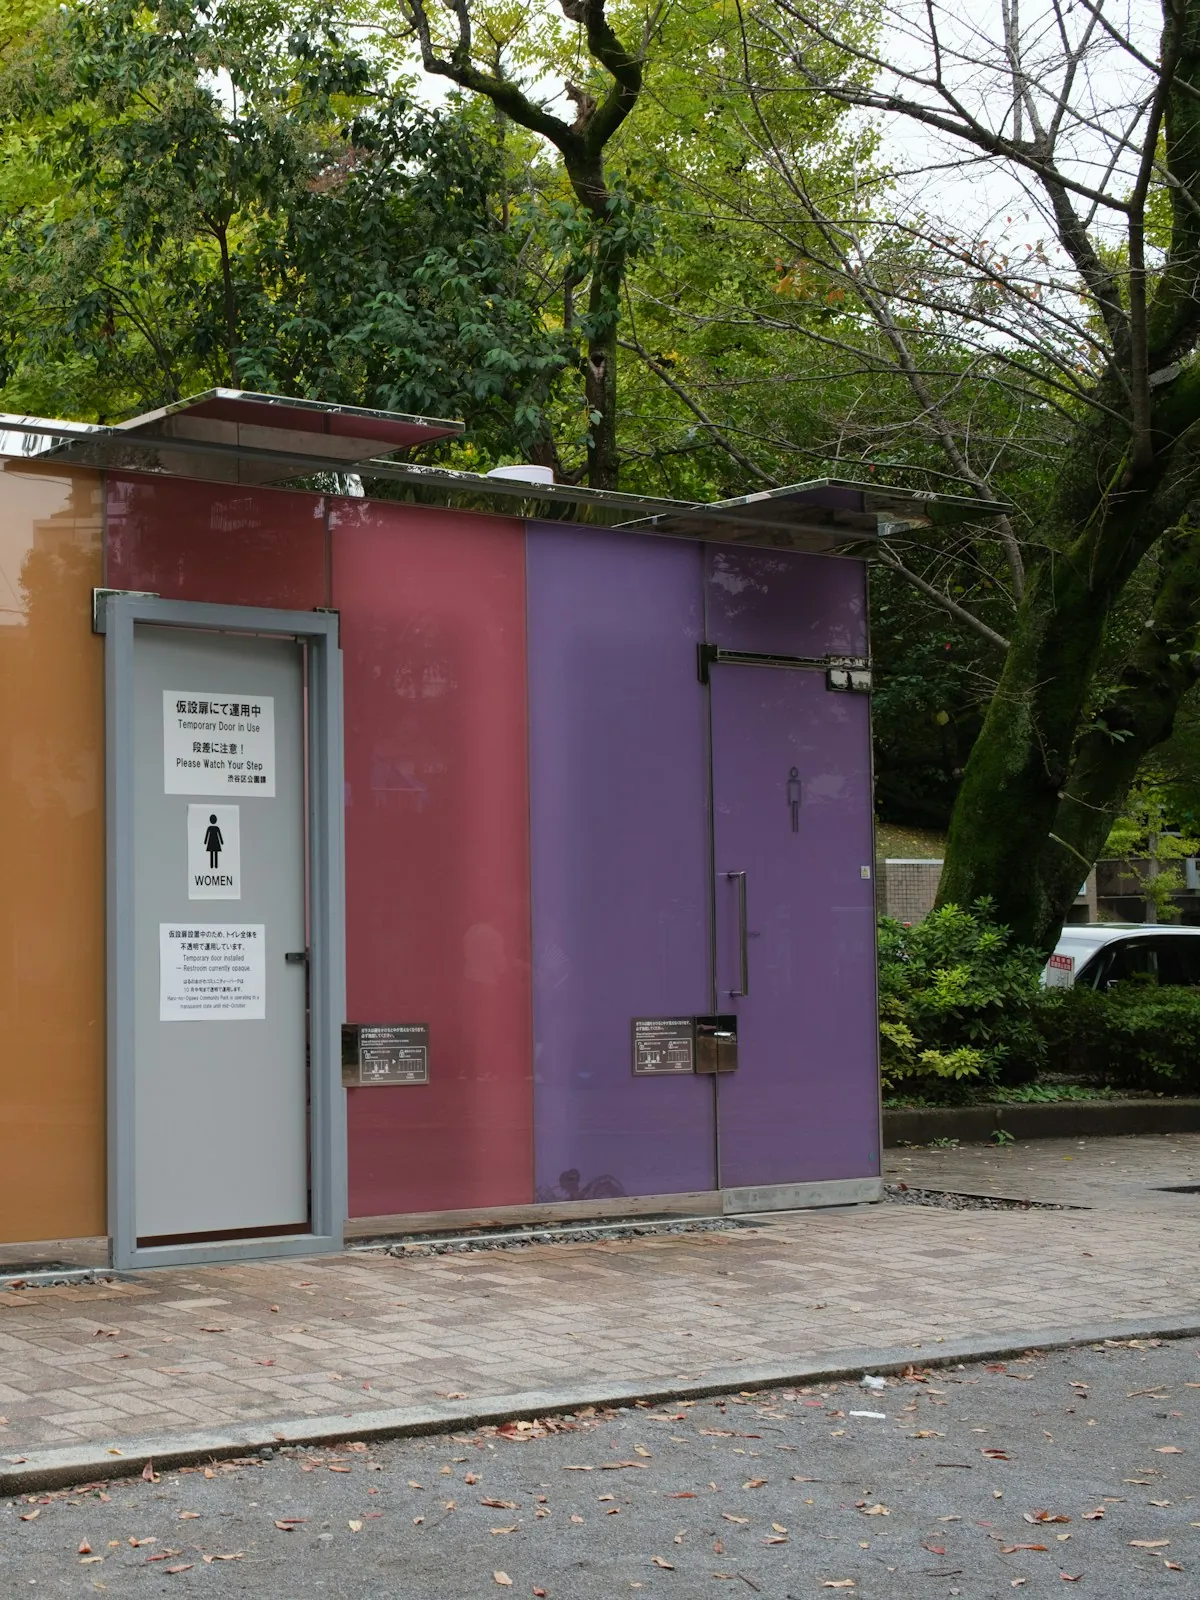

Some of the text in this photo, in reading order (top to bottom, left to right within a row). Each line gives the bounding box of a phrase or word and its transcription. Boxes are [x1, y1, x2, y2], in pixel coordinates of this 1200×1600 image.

[176, 700, 261, 717] 仮設扉にて運用中
[178, 719, 260, 732] Temporary Door in Use
[176, 758, 263, 771] Please Watch Your Step
[195, 876, 233, 886] WOMEN
